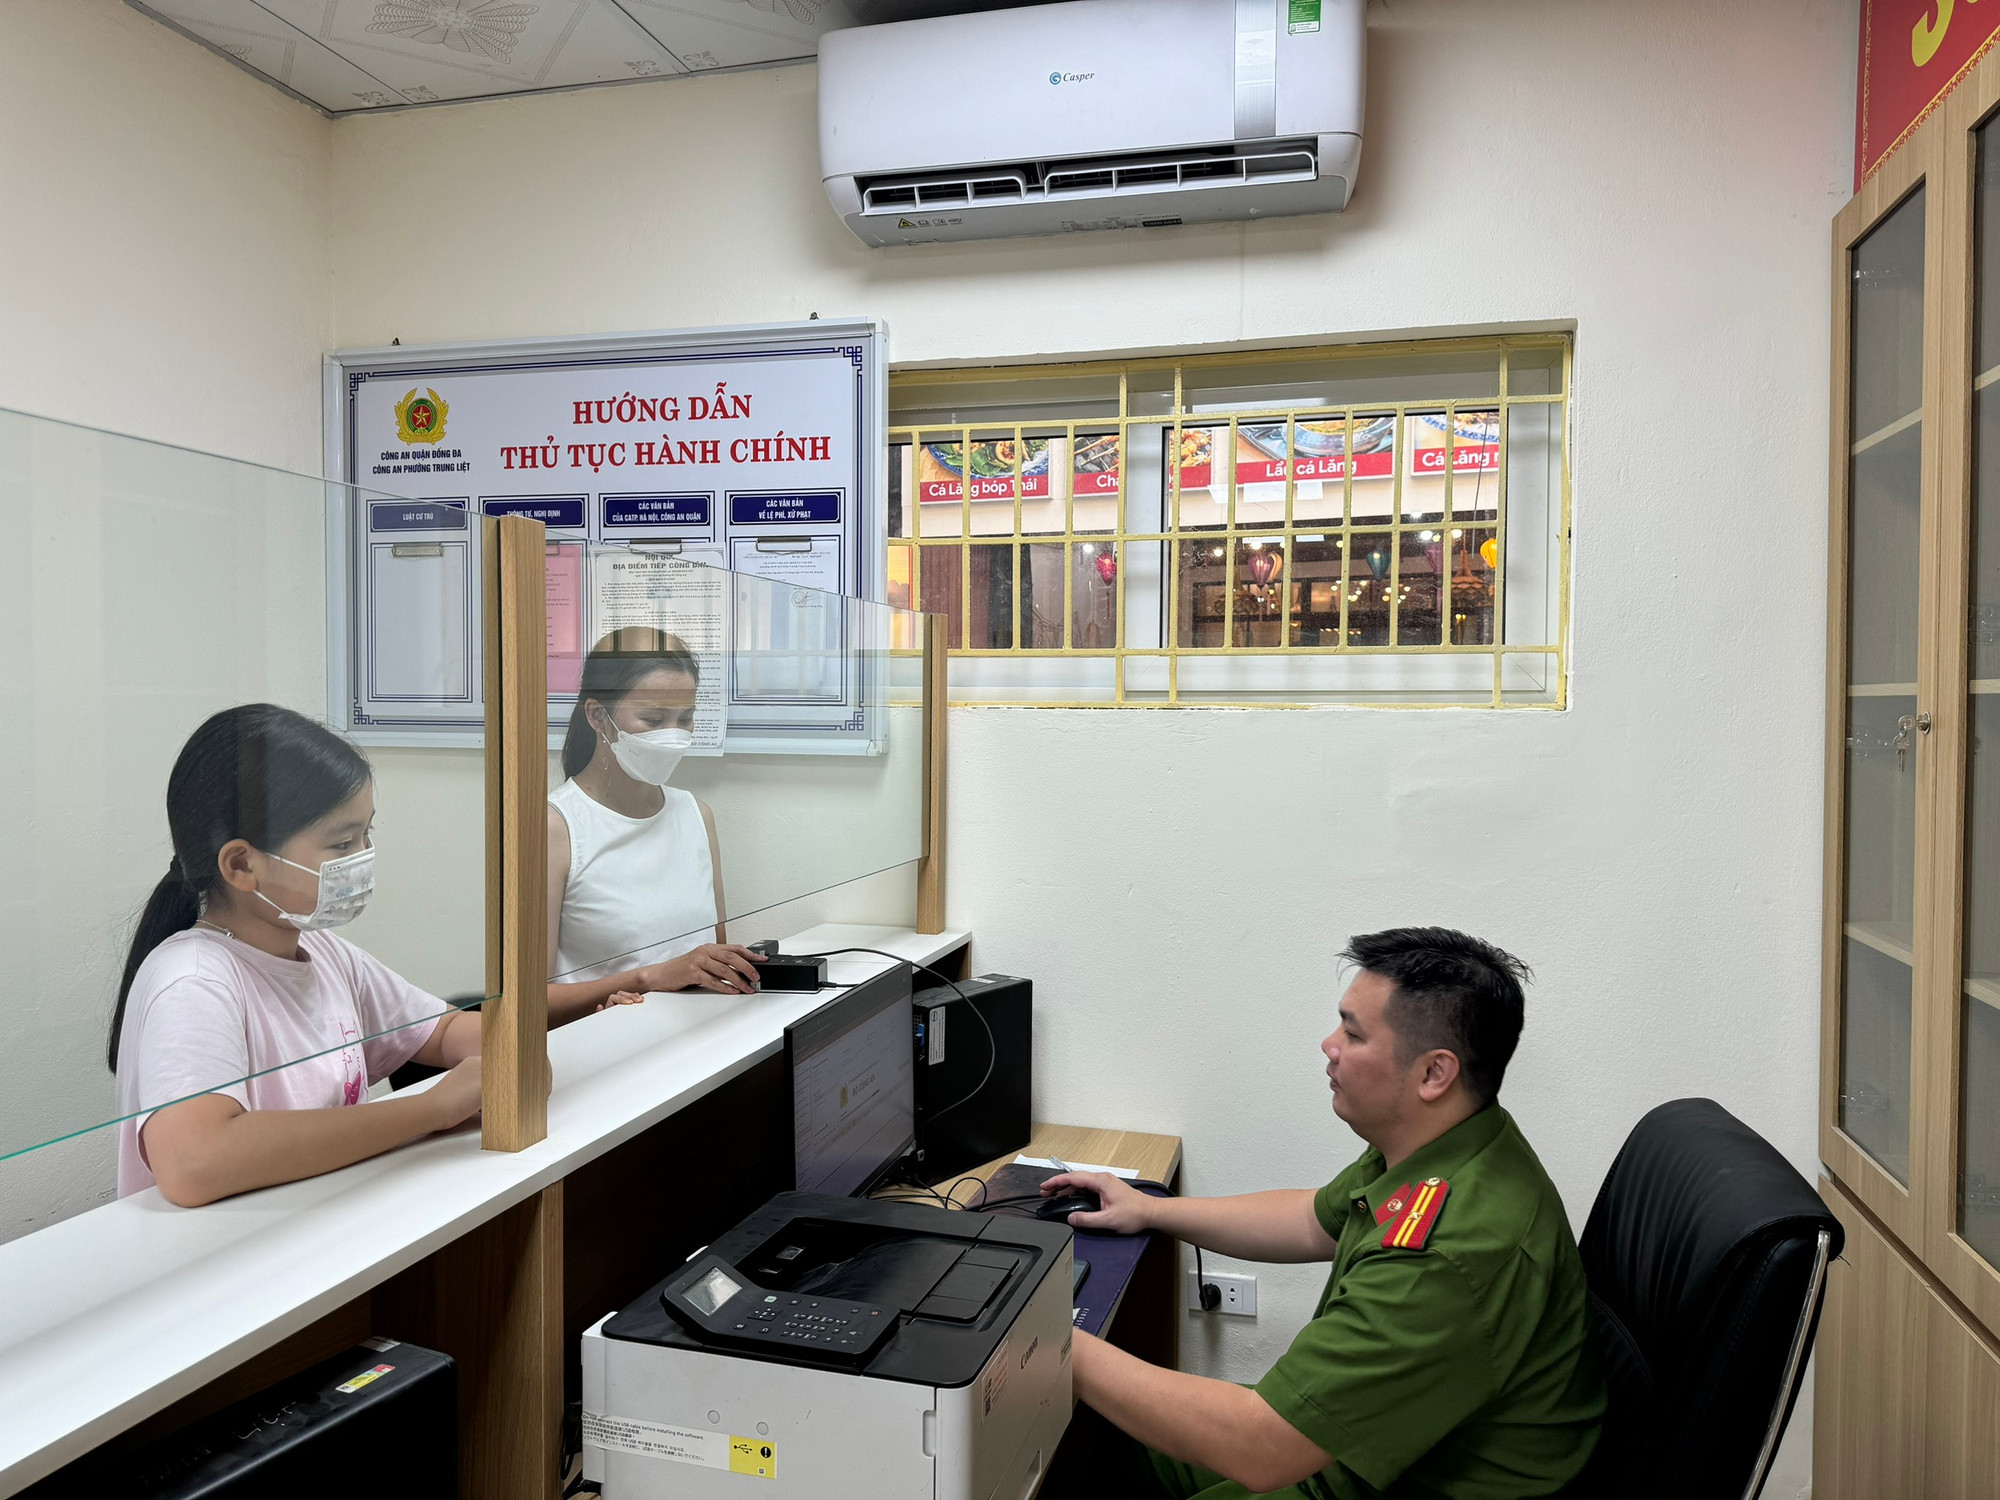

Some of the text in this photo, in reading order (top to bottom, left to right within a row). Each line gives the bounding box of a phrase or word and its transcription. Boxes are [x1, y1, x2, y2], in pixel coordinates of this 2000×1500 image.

[1063, 72, 1095, 83] Casper
[573, 381, 752, 424] HƯỚNG DẪN
[381, 447, 462, 461] CÔNG AN QUẬN ĐỐNG ĐA
[501, 430, 831, 473] THỦ TỤC HÀNH CHÍNH
[1422, 450, 1445, 467] Cá
[1452, 450, 1490, 467] ăng
[372, 461, 471, 474] CÔNG AN PHƯỜNG TRUNG LIỆT
[1296, 460, 1315, 475] cá
[929, 483, 946, 496] Cá
[949, 482, 980, 497] Lăg
[982, 480, 1007, 495] bóp
[638, 500, 675, 510] CÁC VĂN BẢN
[766, 497, 804, 508] CÁC VĂN BẢN
[403, 512, 415, 521] LUẬT
[424, 512, 434, 520] TRÚ
[612, 512, 623, 521] CỦA
[640, 512, 647, 521] HÀ
[661, 512, 675, 521] CÔNG
[677, 512, 685, 520] AN
[686, 511, 701, 522] QUẬN
[767, 510, 774, 520] LỆ
[796, 510, 811, 520] PHẠT
[613, 562, 626, 571] ĐỊA
[628, 560, 648, 569] ĐIỂM
[650, 560, 667, 569] TIẾP
[669, 561, 690, 569] CÔNG
[1020, 1336, 1038, 1370] Canon
[656, 1428, 676, 1436] installing
